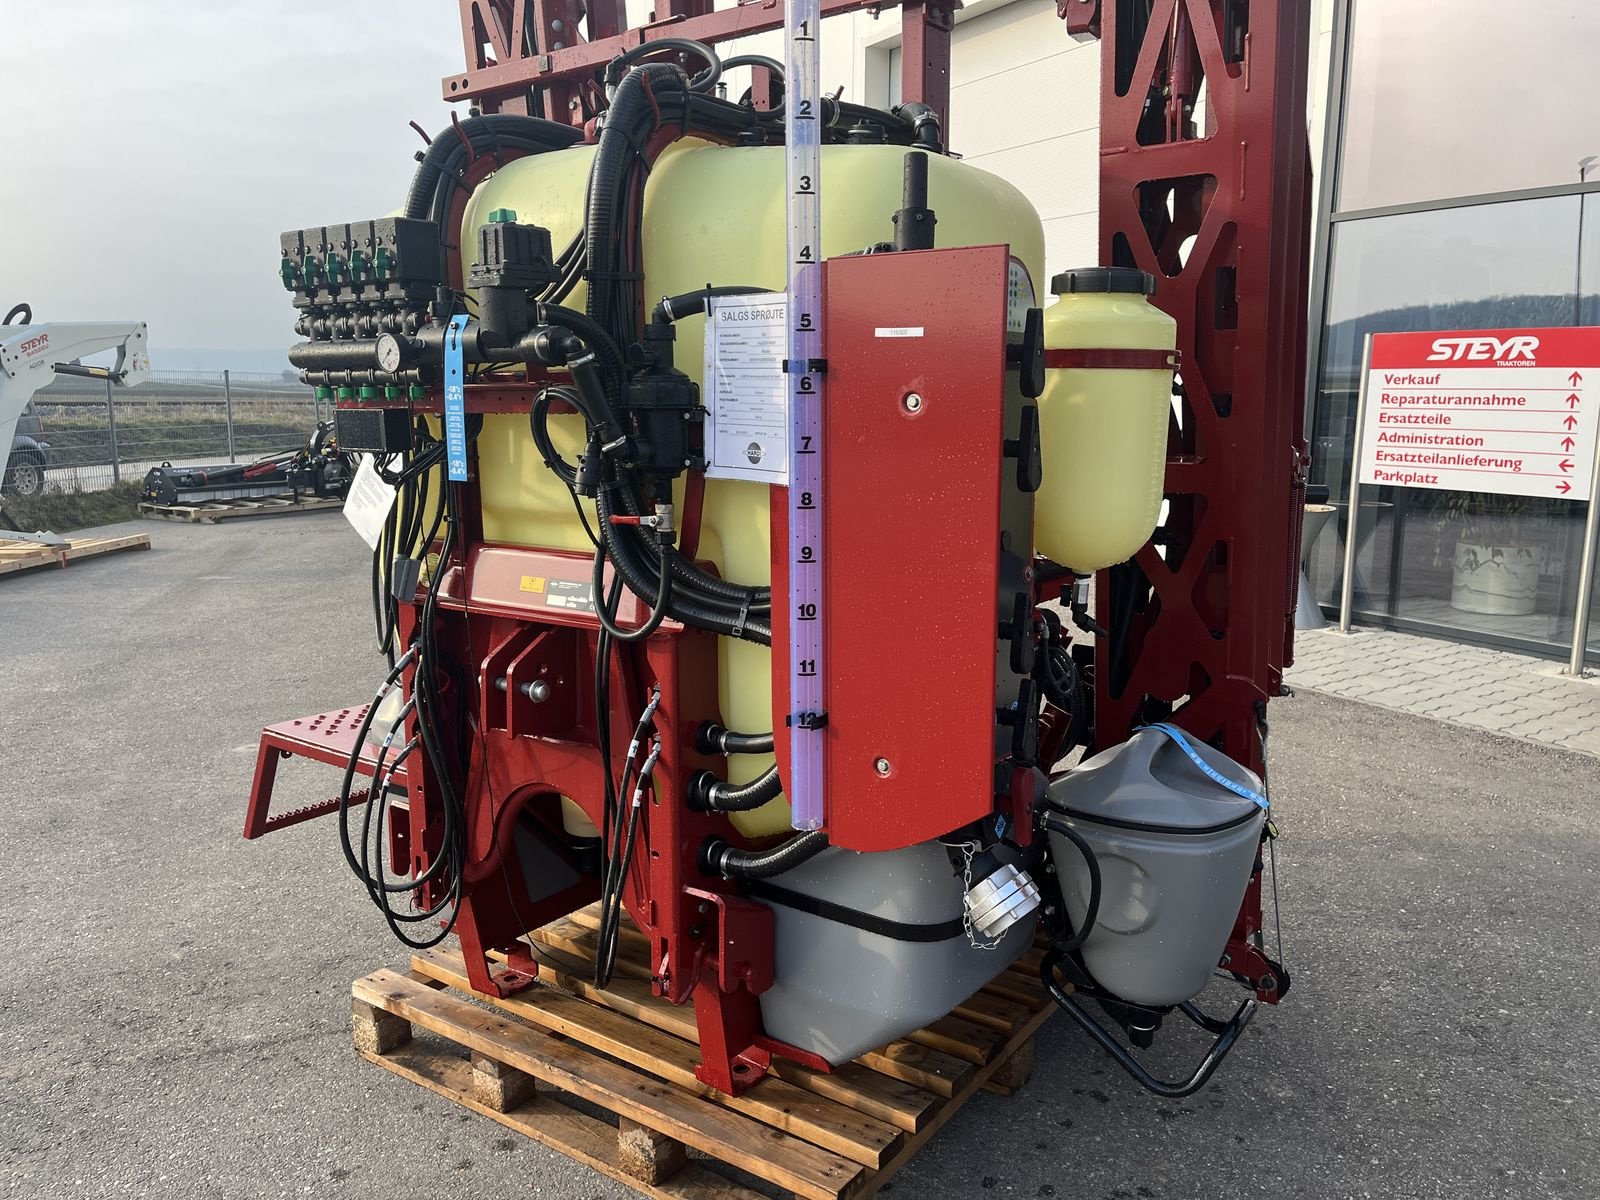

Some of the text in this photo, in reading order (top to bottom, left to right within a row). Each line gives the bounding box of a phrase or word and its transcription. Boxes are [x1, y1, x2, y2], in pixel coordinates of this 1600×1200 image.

[800, 21, 807, 36] 1
[800, 100, 811, 115] 2
[800, 175, 811, 191] 3
[800, 245, 811, 260] 4
[721, 309, 784, 321] SALGS SPRØJTE
[800, 313, 812, 328] 5
[21, 334, 48, 353] STEYR
[1426, 336, 1540, 360] STEYR
[800, 376, 812, 391] 6
[1384, 374, 1441, 385] Verkauf
[1381, 393, 1527, 408] Reparaturannahme
[1379, 412, 1452, 425] Ersatzteile
[801, 436, 812, 450] 7
[1378, 431, 1484, 446] Administration
[1375, 450, 1523, 472] Ersatzteilanlieferung
[1373, 469, 1439, 485] Parkplatz
[800, 492, 812, 506] 8
[801, 546, 812, 560] 9
[798, 604, 816, 617] 10
[799, 660, 815, 673] 11
